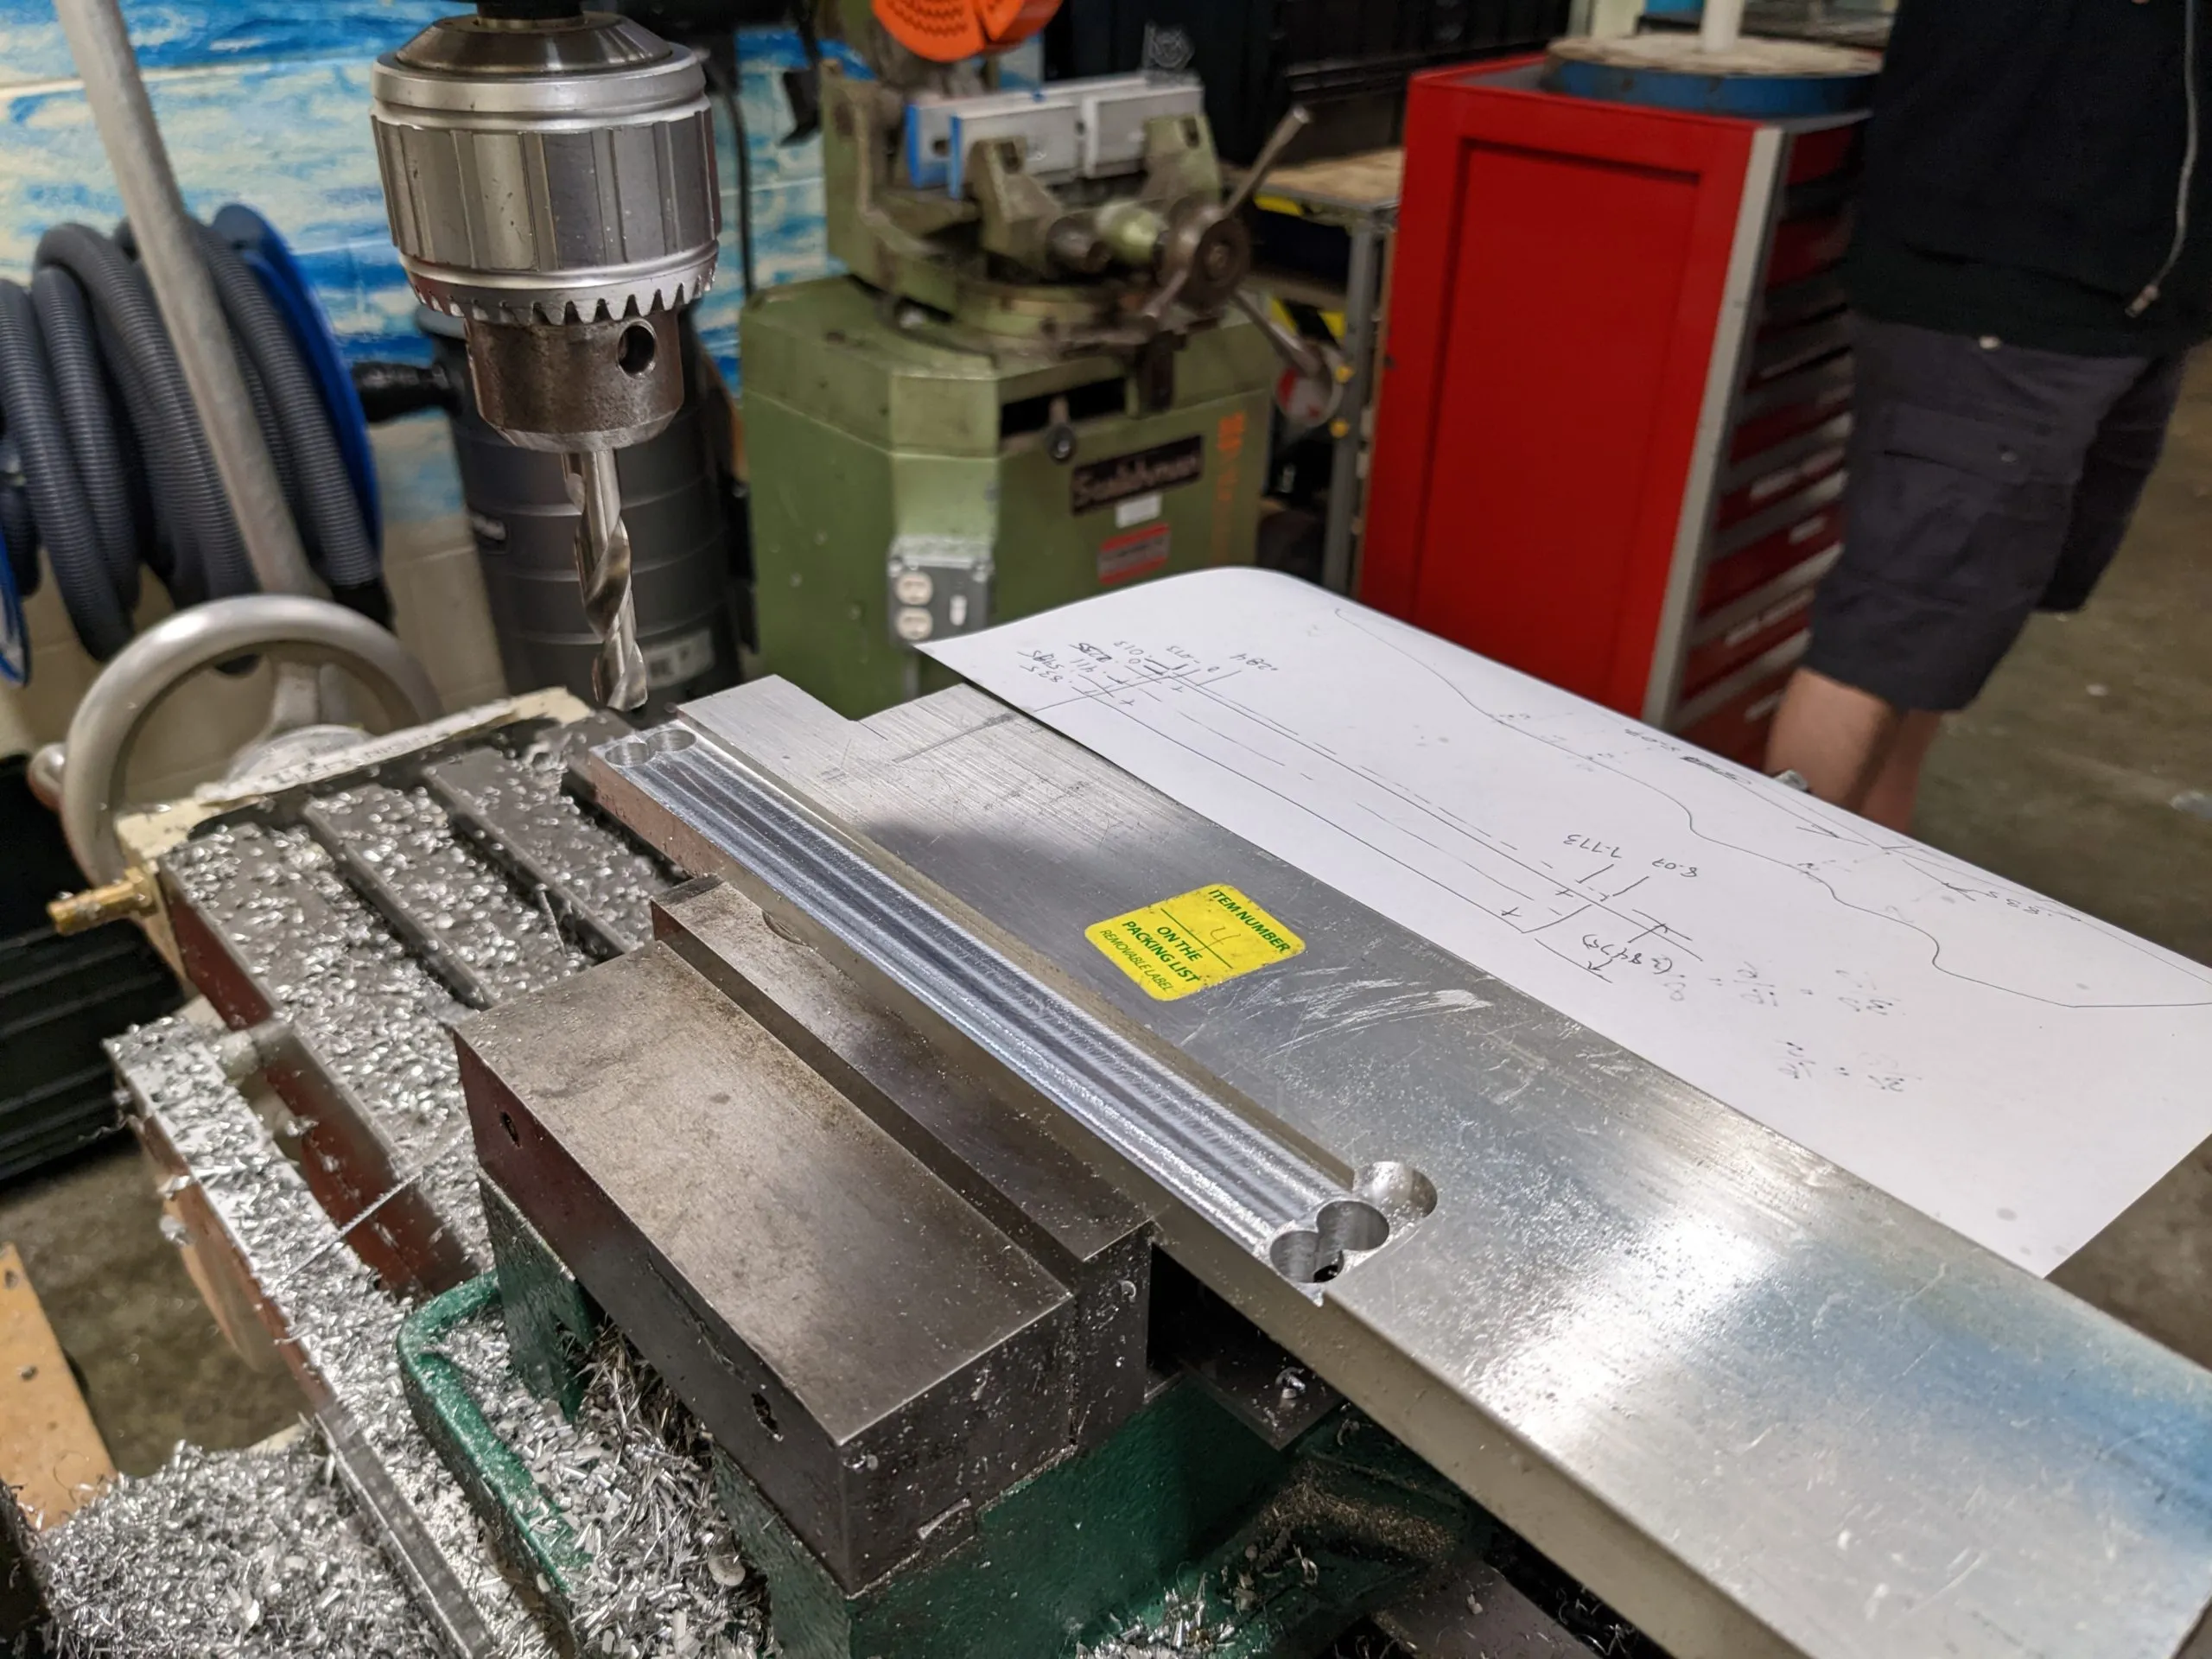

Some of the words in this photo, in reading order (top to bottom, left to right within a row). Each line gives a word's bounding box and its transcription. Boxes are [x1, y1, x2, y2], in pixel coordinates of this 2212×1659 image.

[1122, 920, 1176, 963] PACKING
[1169, 960, 1201, 982] LIST
[1156, 925, 1178, 943] ON
[1173, 938, 1204, 963] THE
[1207, 888, 1241, 912] ITEM
[1236, 908, 1292, 953] NUMBER
[1100, 930, 1151, 973] REMOVABLE
[1145, 969, 1175, 992] LABEL
